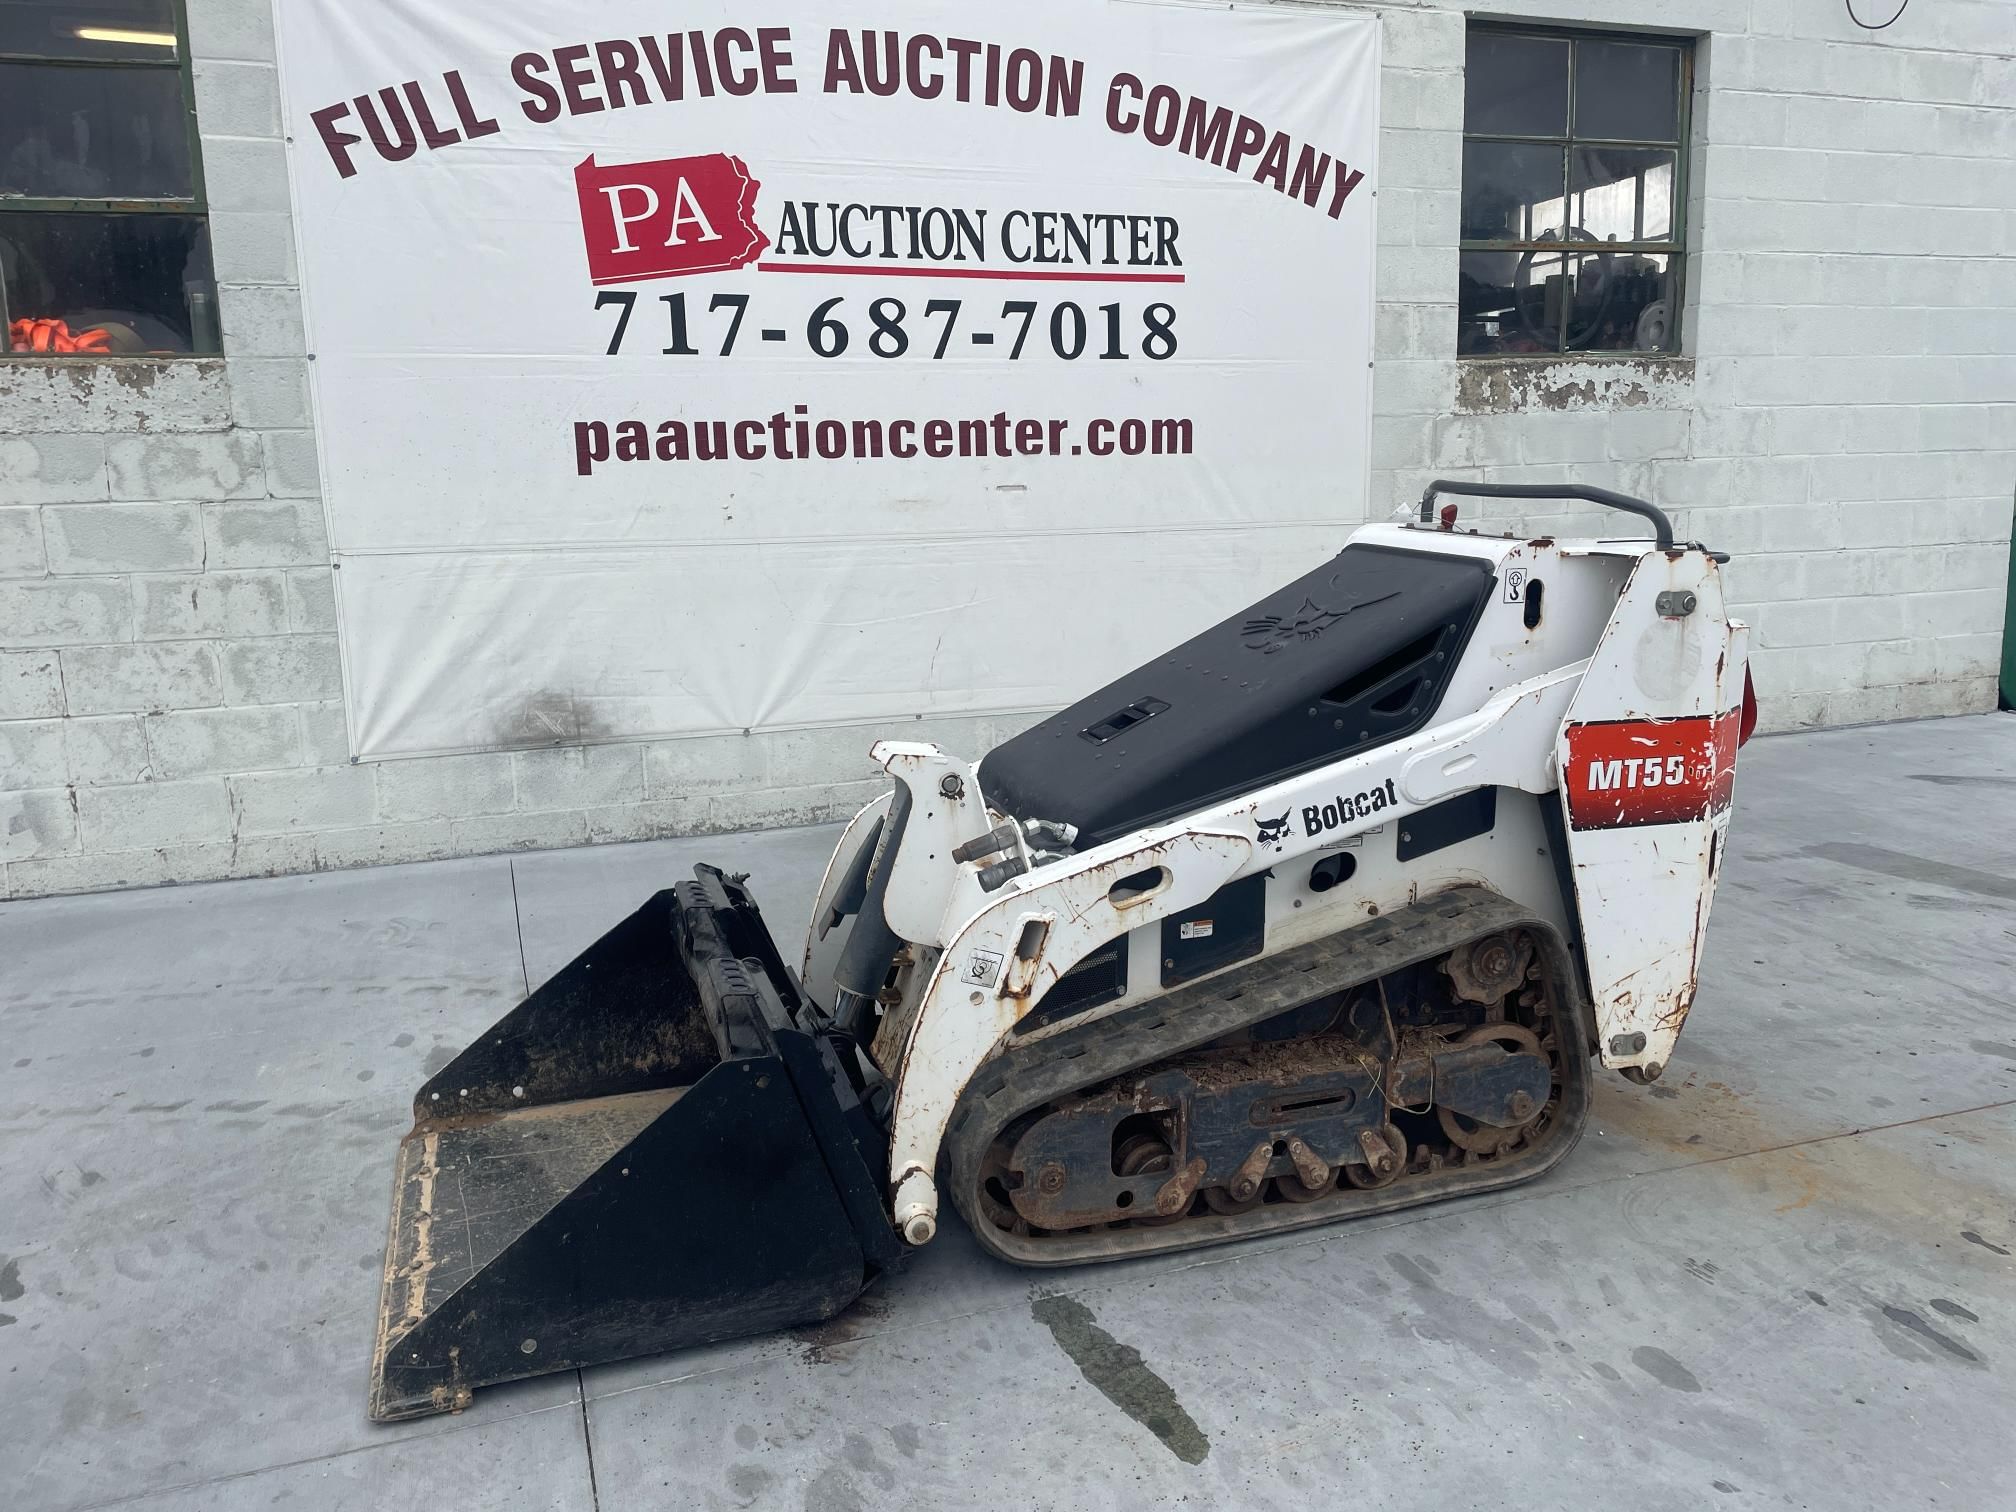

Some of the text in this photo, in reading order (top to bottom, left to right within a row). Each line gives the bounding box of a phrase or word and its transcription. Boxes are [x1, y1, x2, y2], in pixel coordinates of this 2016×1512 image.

[309, 27, 1365, 220] FULL SERVICE AUCTION COMPANY
[598, 176, 1183, 267] PA AUCTION CENTER
[593, 290, 1178, 361] 717-687-7018
[573, 404, 1193, 476] paauctioncenter.com
[1301, 777, 1398, 838] Bobcat
